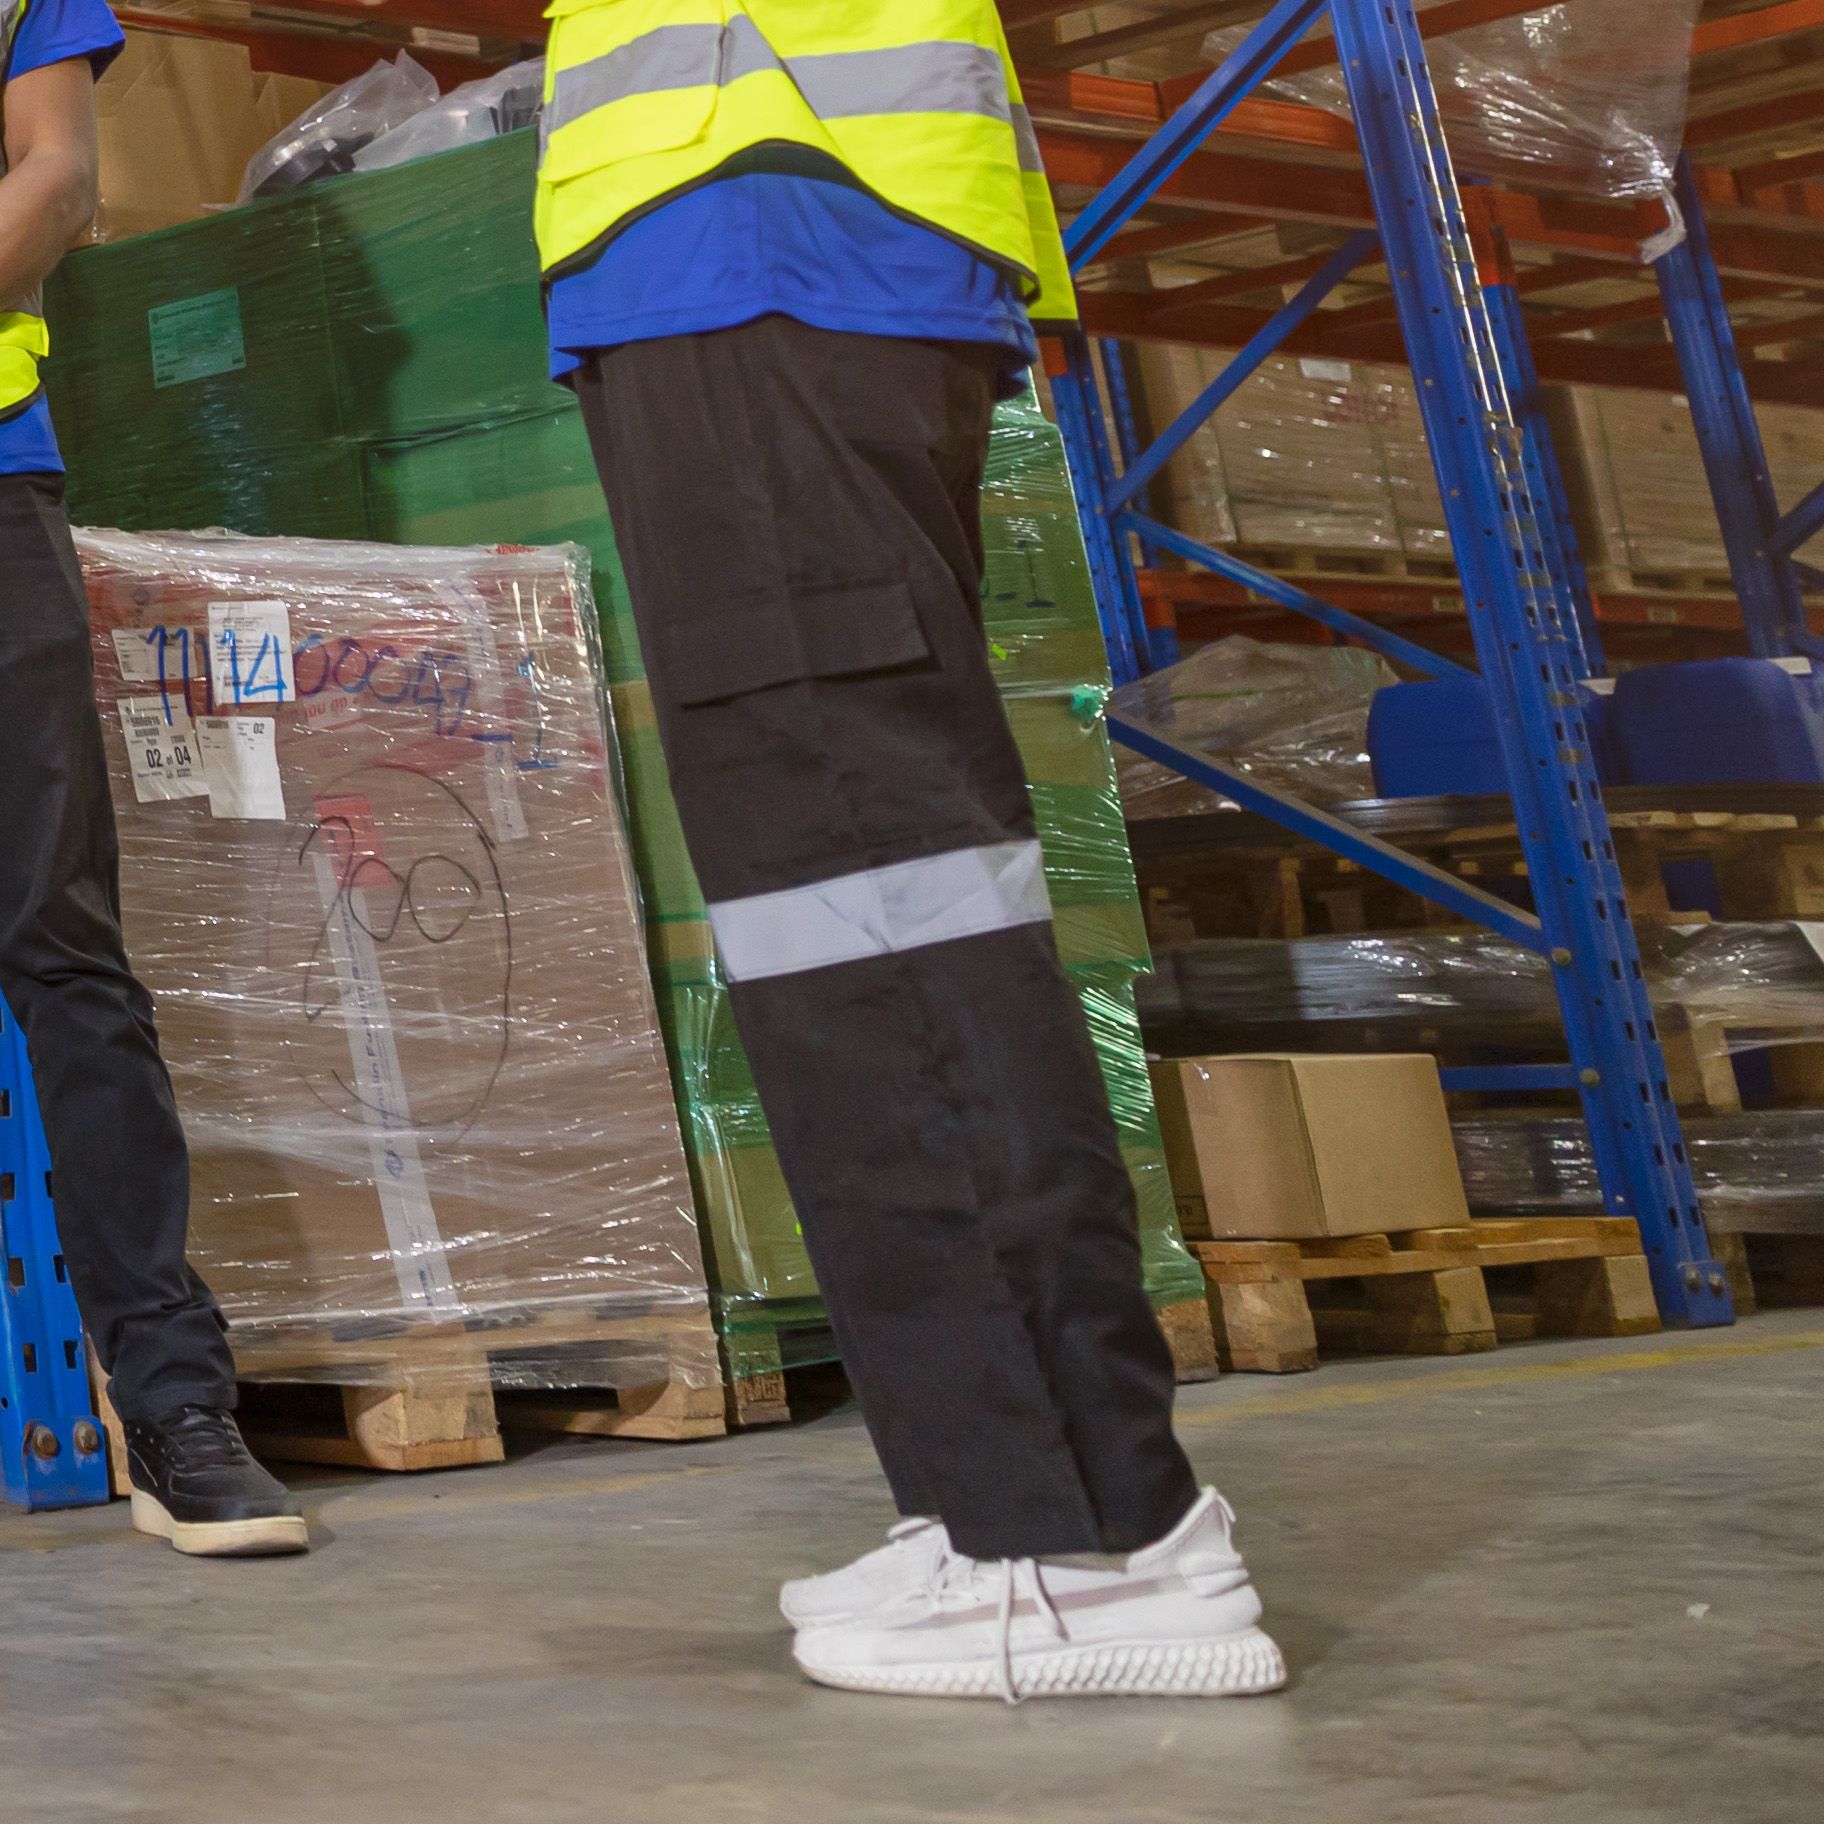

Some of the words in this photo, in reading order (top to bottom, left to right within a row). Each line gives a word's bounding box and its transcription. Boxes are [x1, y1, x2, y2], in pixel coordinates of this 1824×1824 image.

[253, 723, 265, 735] 02
[145, 748, 164, 768] 02
[173, 745, 192, 766] 04
